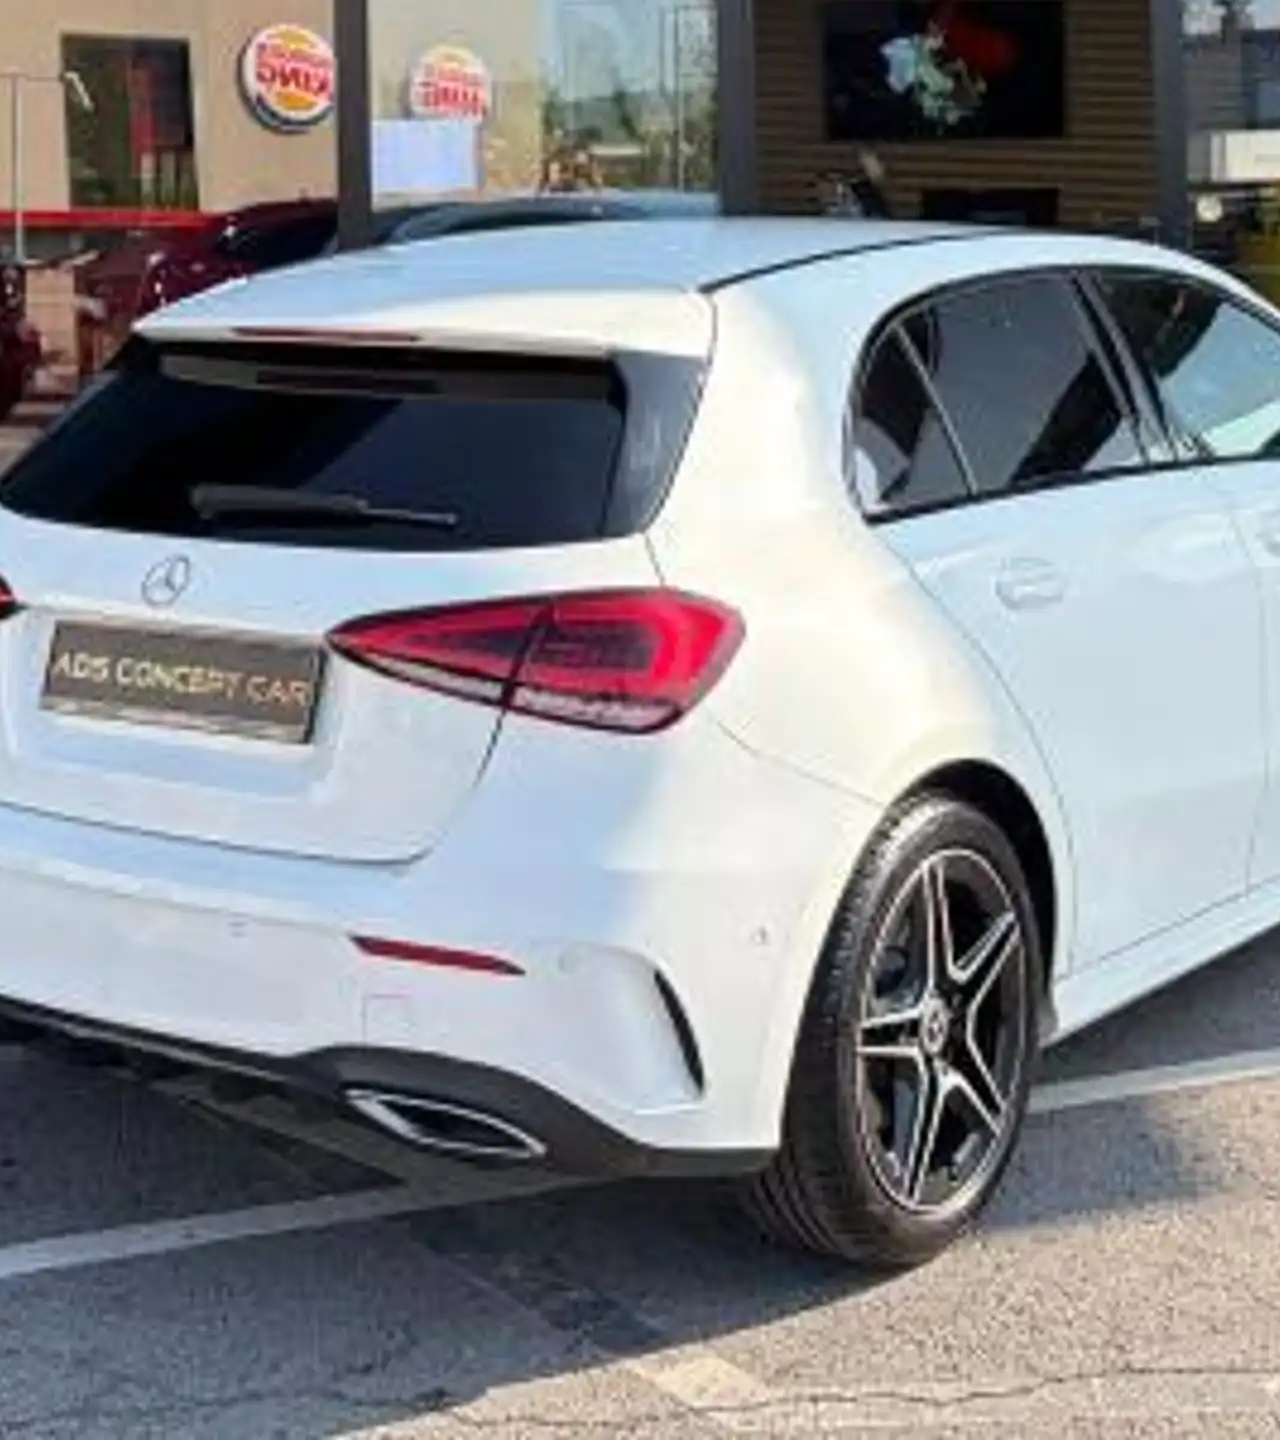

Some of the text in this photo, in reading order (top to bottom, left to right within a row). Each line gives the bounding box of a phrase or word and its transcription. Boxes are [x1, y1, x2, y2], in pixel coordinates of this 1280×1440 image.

[51, 651, 310, 706] ADS CONCEPT CAR
